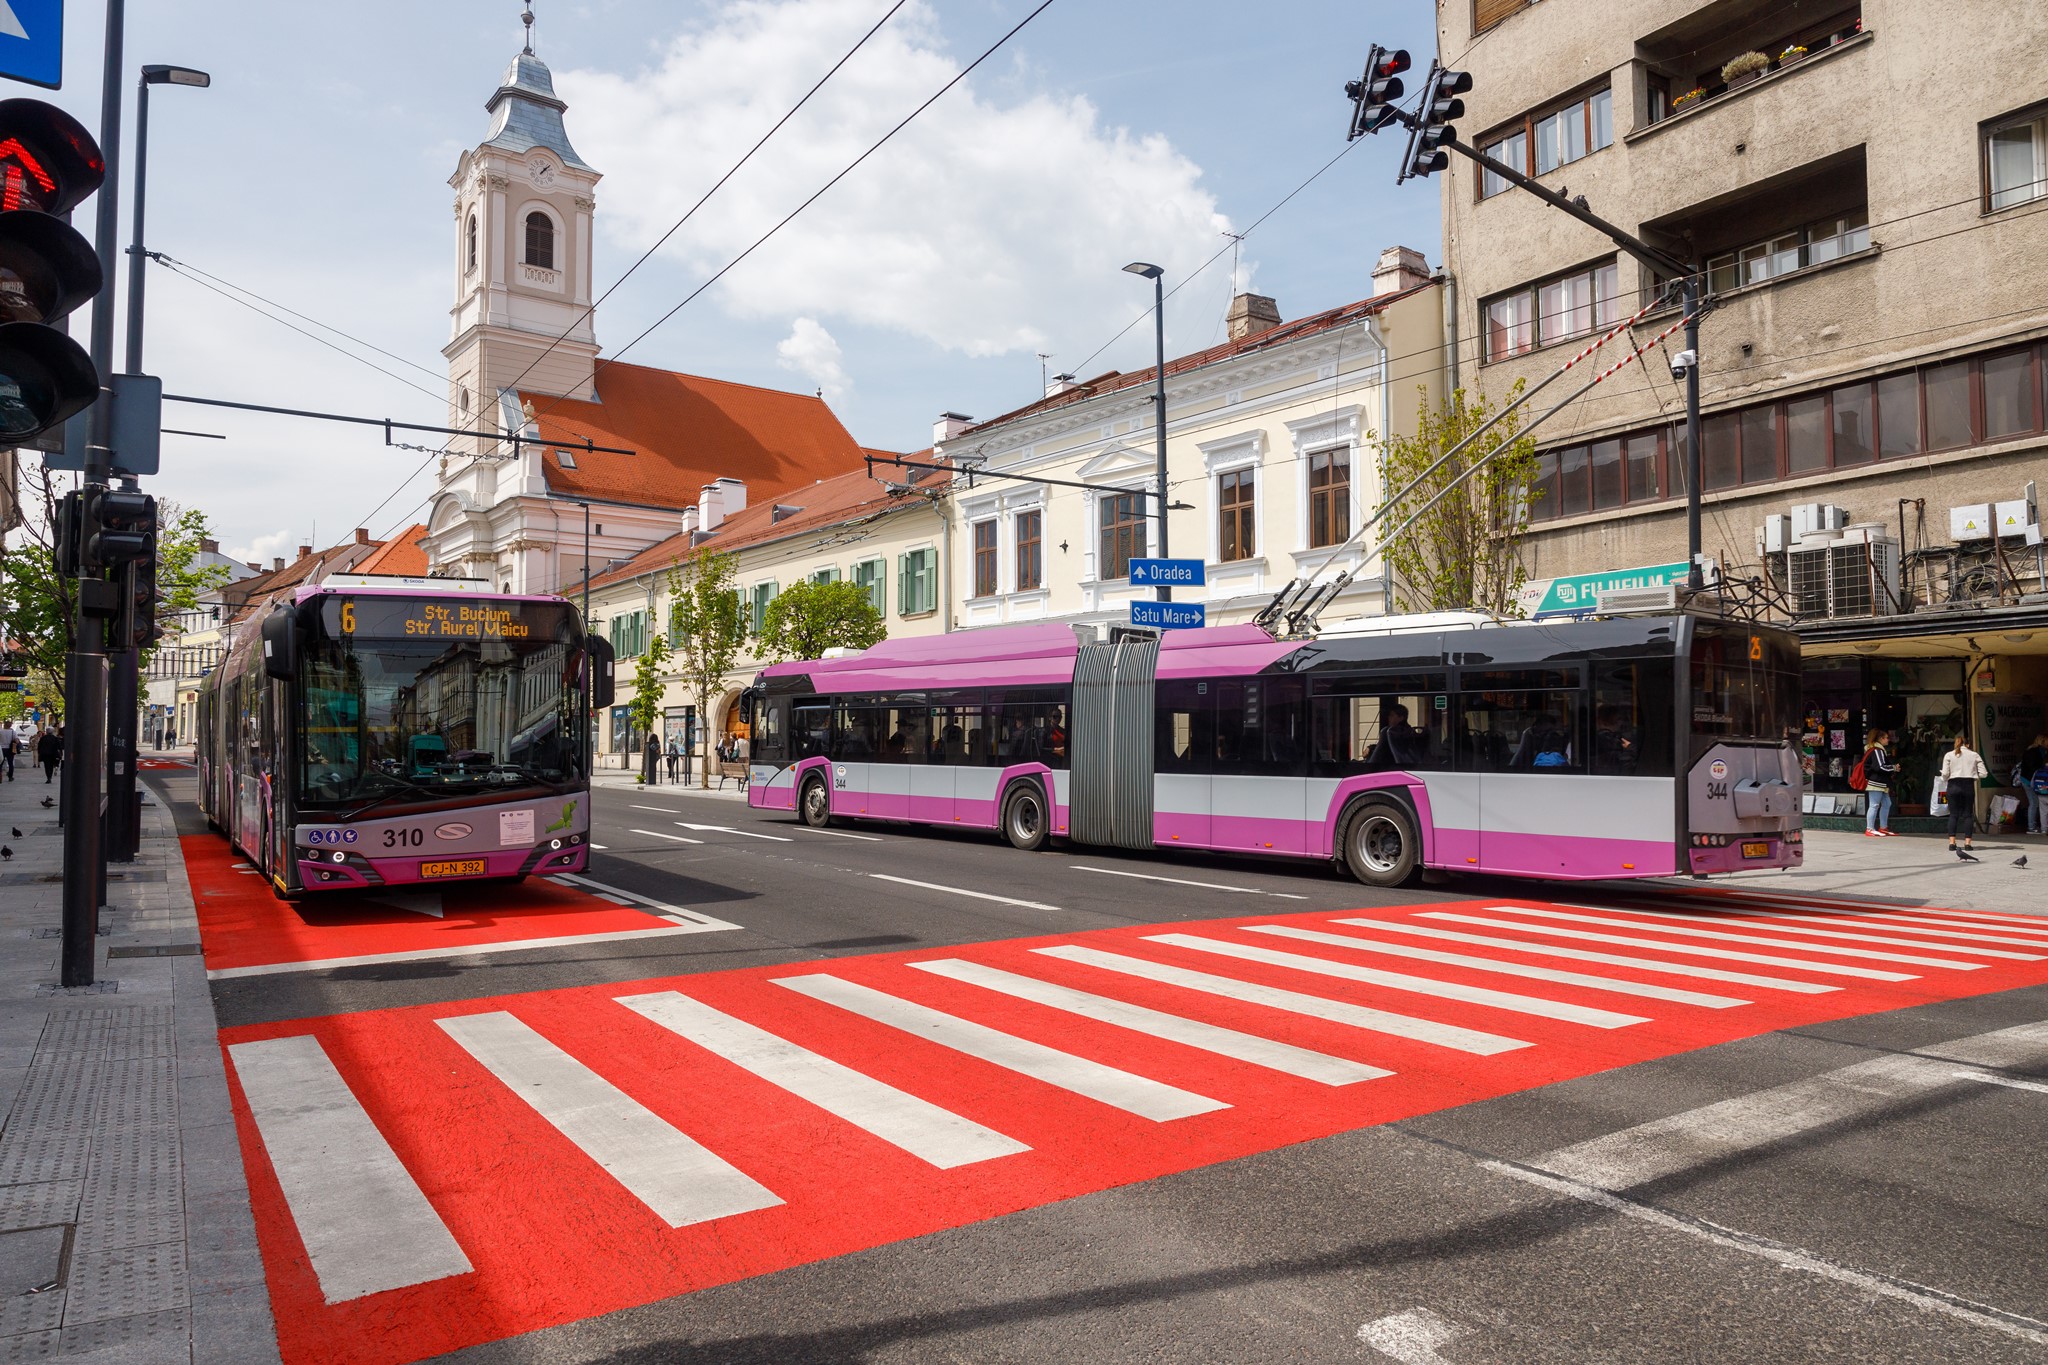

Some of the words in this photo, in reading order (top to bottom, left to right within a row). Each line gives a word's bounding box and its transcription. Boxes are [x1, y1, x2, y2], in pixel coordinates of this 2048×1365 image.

[1150, 564, 1192, 580] Oradea
[342, 602, 356, 633] 6
[425, 605, 455, 620] Str.
[459, 607, 510, 622] Bucium
[1133, 606, 1160, 622] Satu
[1163, 608, 1191, 624] Mare
[405, 619, 435, 635] Str.
[441, 620, 479, 636] Aurel
[485, 621, 529, 637] Vlaicu
[835, 778, 846, 789] 344
[1706, 782, 1728, 799] 344
[382, 828, 424, 848] 310
[430, 863, 458, 874] CJ-N
[461, 861, 480, 873] 392
